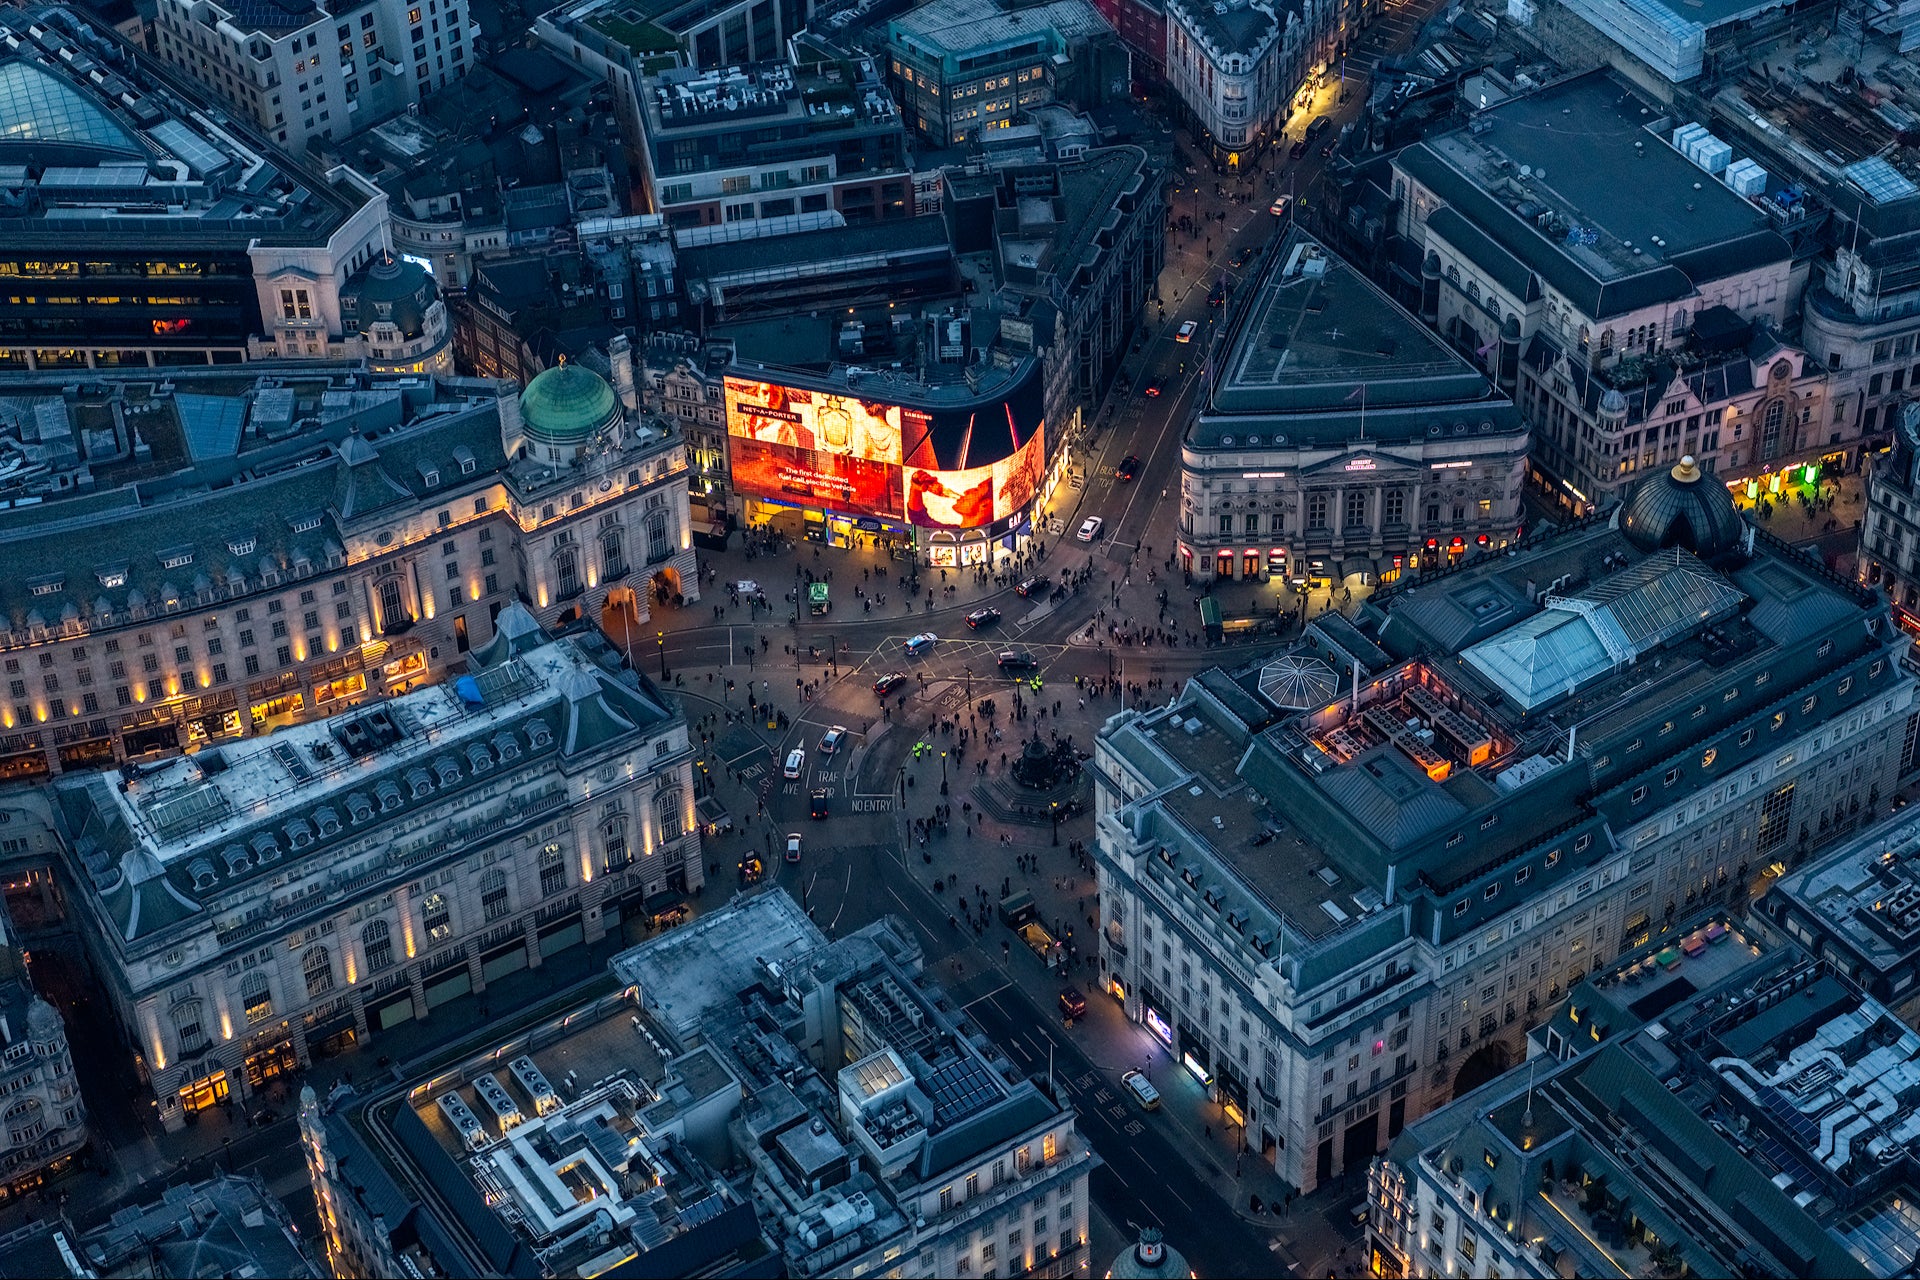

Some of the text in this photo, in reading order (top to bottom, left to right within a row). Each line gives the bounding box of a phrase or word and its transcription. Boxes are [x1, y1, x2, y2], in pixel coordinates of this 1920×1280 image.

[742, 405, 797, 420] NET-A-PORTER
[904, 411, 933, 421] SAMSUNG
[778, 472, 792, 481] fuel
[805, 478, 831, 488] electric
[831, 482, 857, 493] vehicle
[785, 466, 849, 484] The first dedicated
[818, 770, 840, 783] TRAF
[782, 783, 800, 795] AVE
[851, 799, 892, 811] NO ENTRY
[1094, 1087, 1115, 1104] AVE
[1108, 1103, 1128, 1120] TRF
